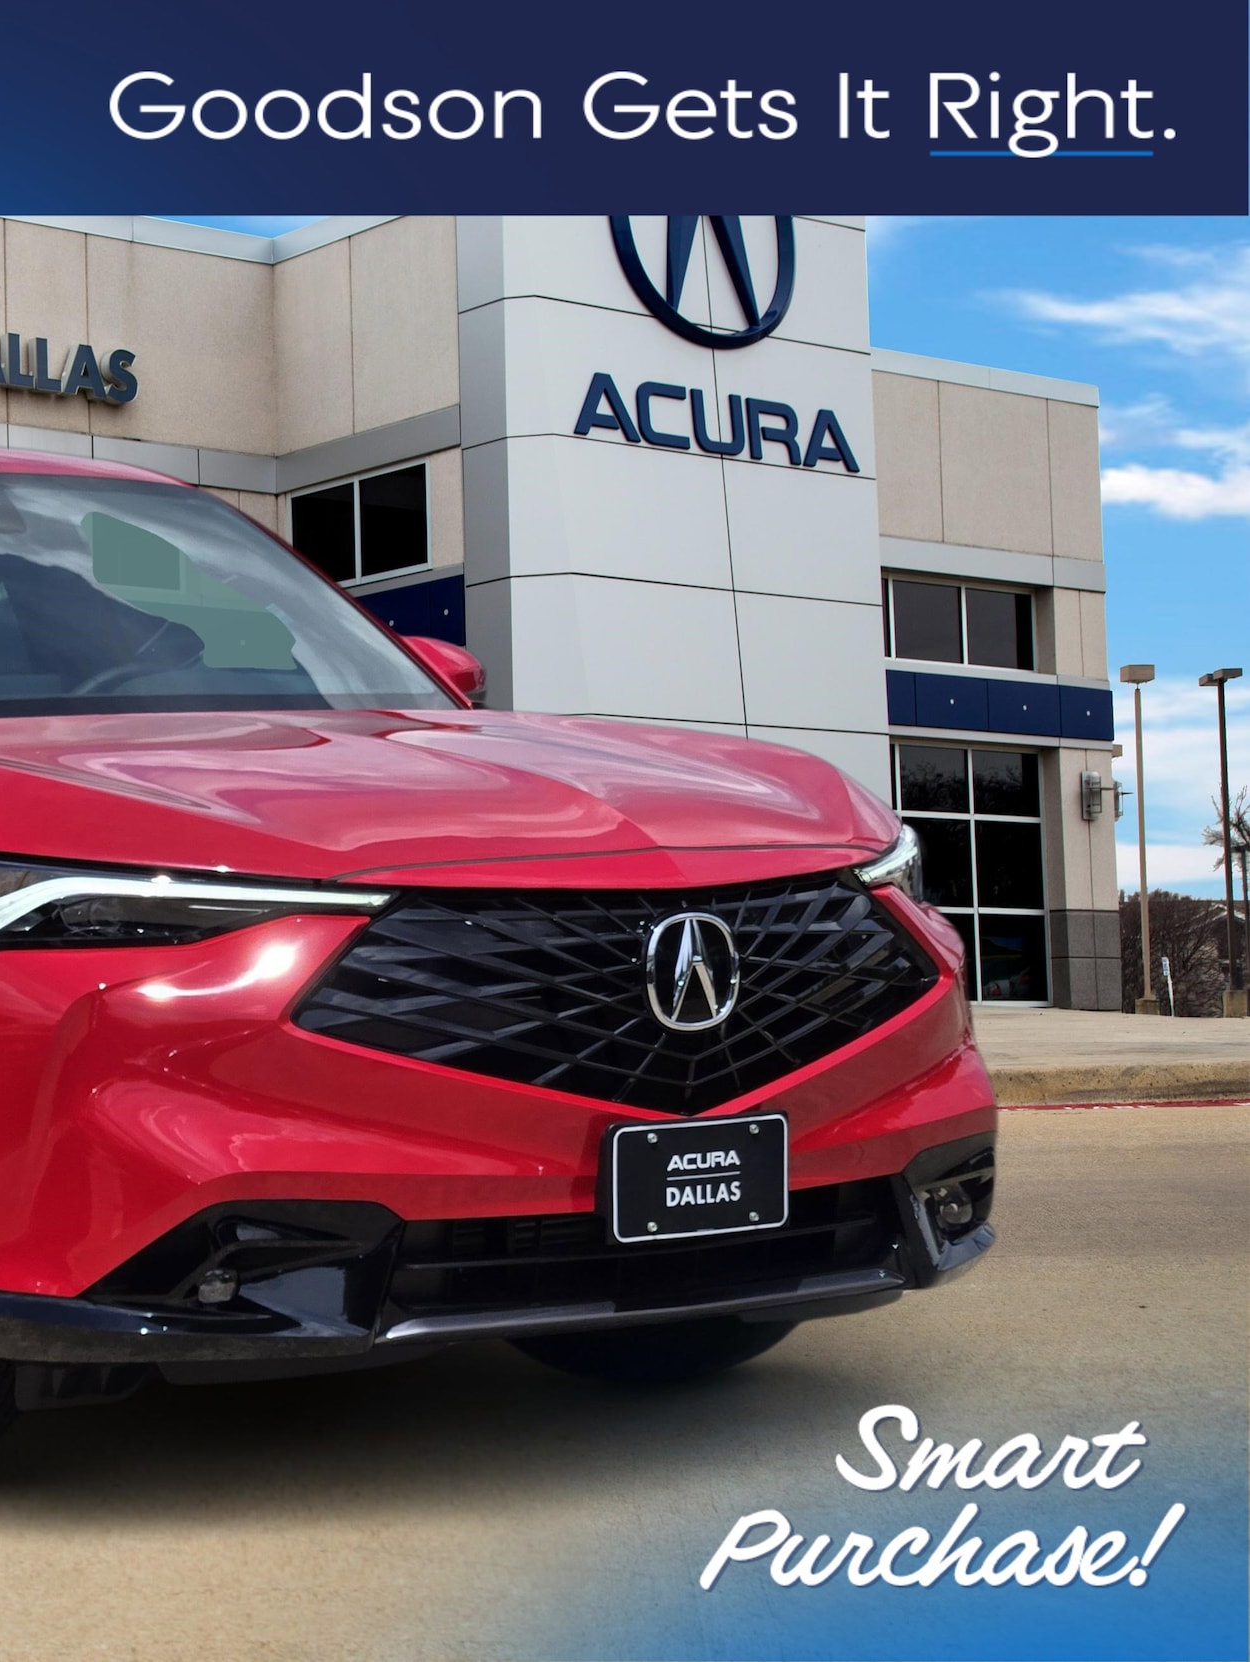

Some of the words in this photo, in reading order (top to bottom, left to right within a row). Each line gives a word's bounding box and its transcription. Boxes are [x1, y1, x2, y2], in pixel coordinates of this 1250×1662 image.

[573, 372, 861, 474] ACURA
[667, 1151, 740, 1171] ACURA
[667, 1182, 740, 1206] DALLAS
